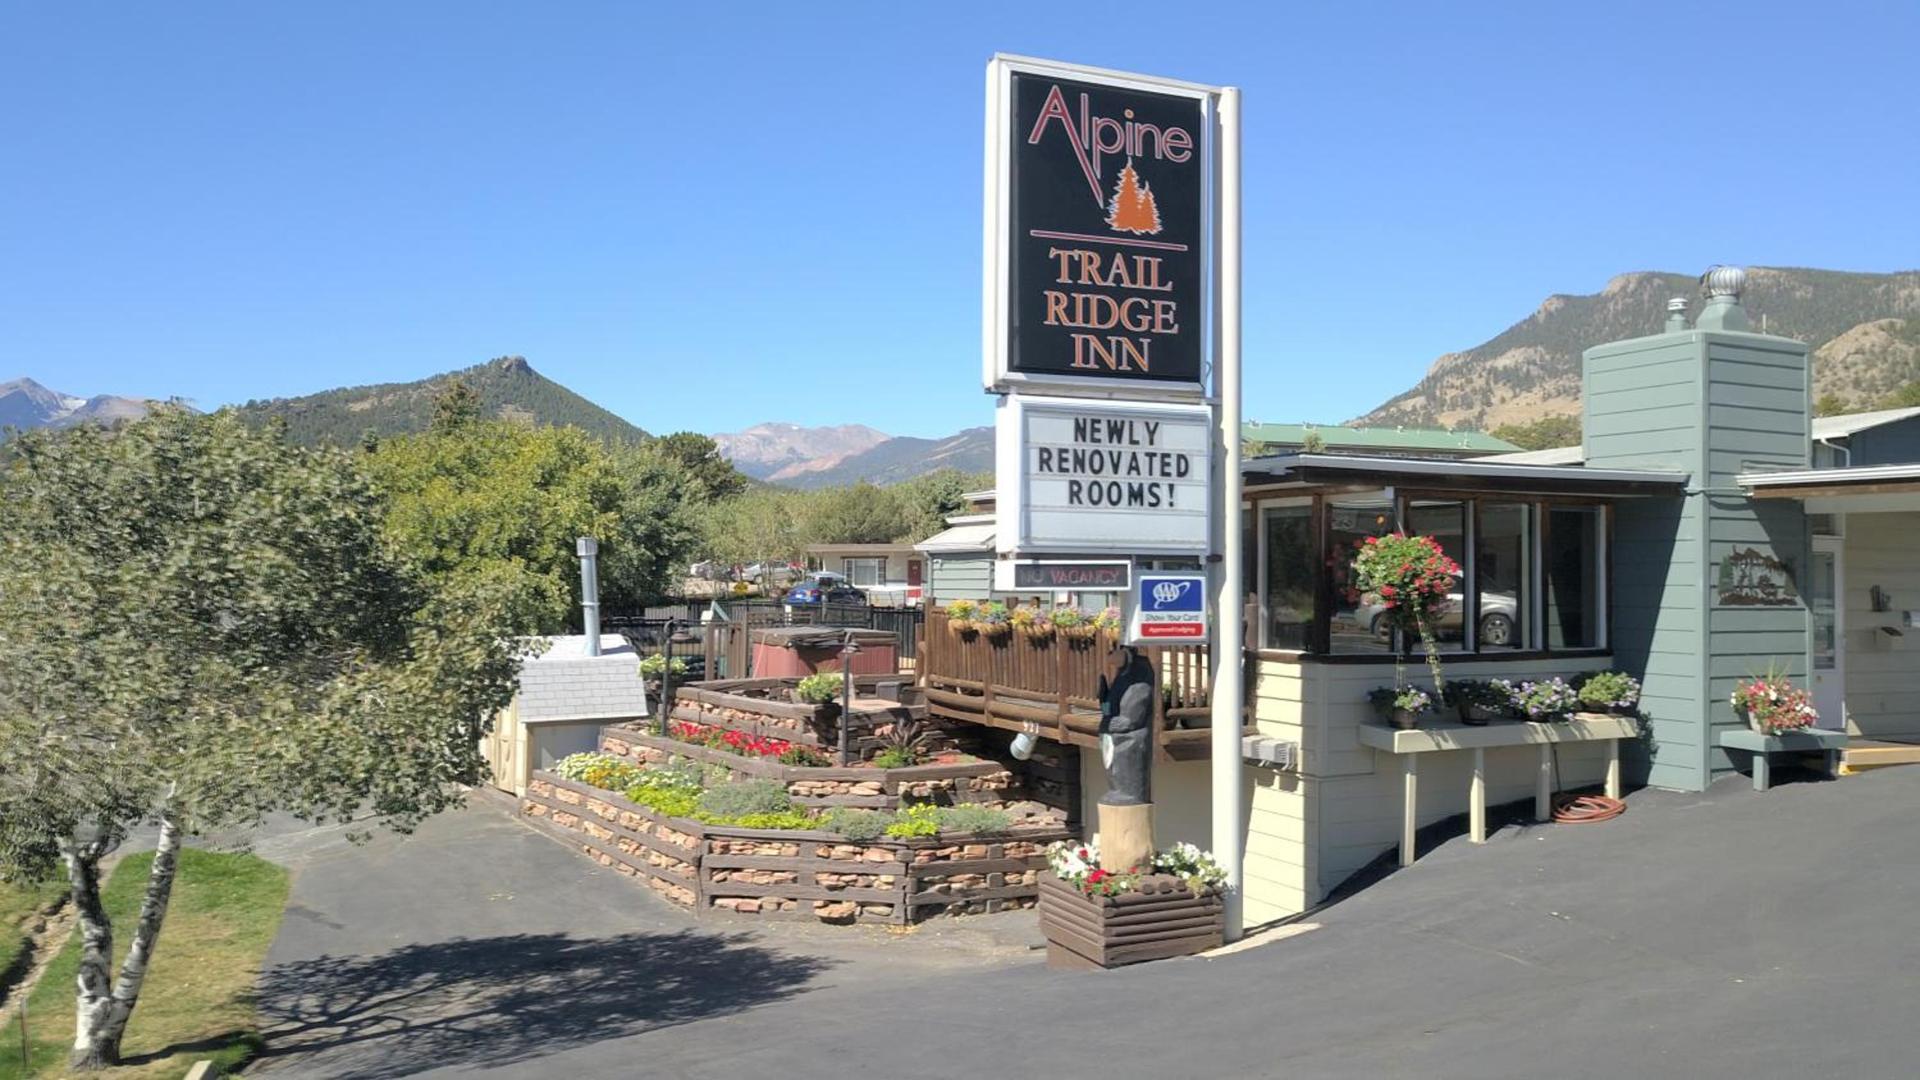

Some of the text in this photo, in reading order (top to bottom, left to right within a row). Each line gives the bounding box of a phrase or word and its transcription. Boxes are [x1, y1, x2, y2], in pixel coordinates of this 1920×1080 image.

[1028, 84, 1193, 210] Alpine
[1049, 247, 1173, 291] TRAIL
[1043, 290, 1179, 334] RIDGE
[1071, 333, 1151, 372] INN
[1074, 417, 1159, 446] NEWLY
[1039, 447, 1189, 478] RENOVATED
[1069, 480, 1175, 507] ROOMS!
[1050, 569, 1120, 585] VACANCY
[1145, 613, 1165, 621] Show
